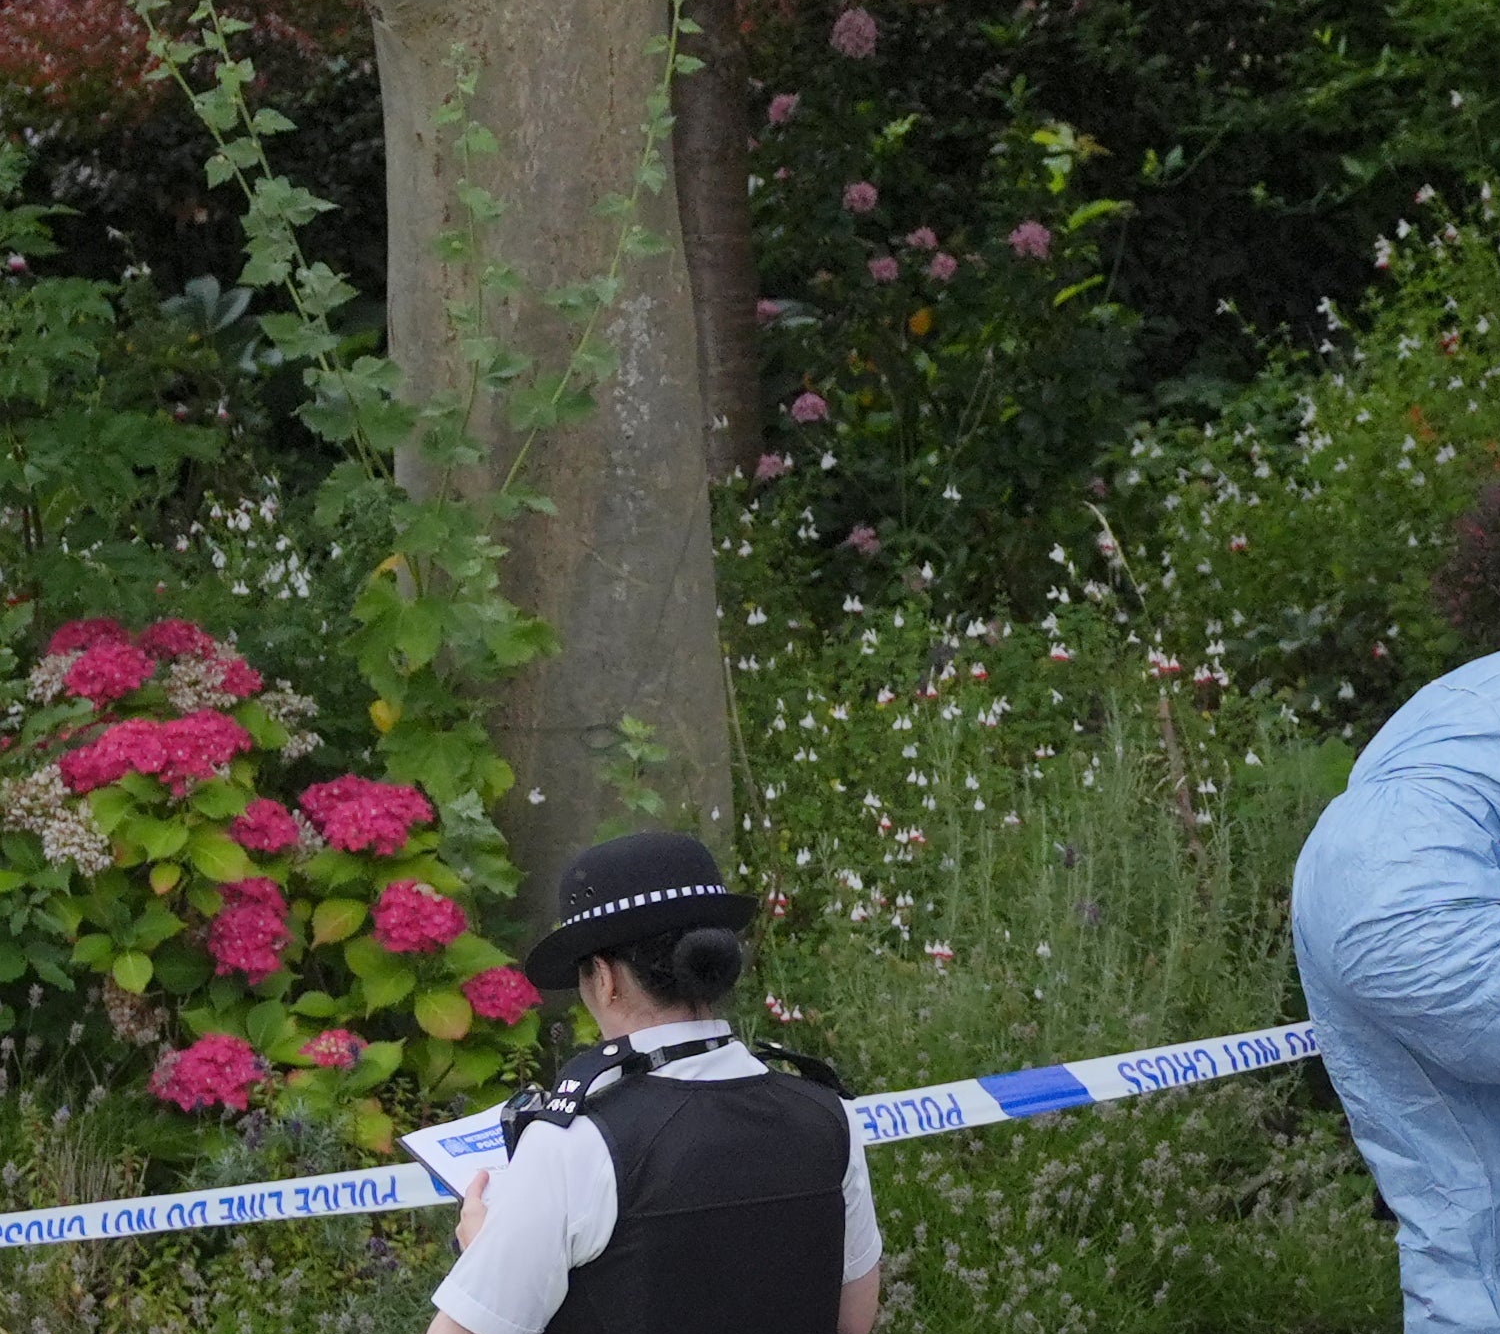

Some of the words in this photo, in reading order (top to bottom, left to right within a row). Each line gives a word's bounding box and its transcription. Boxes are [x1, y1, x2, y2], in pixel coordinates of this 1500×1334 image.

[1117, 1048, 1218, 1095] CROSS
[1224, 1035, 1281, 1072] NOT
[855, 1091, 965, 1142] POLICE
[218, 1190, 285, 1223] LINE
[294, 1174, 404, 1214] POLICE
